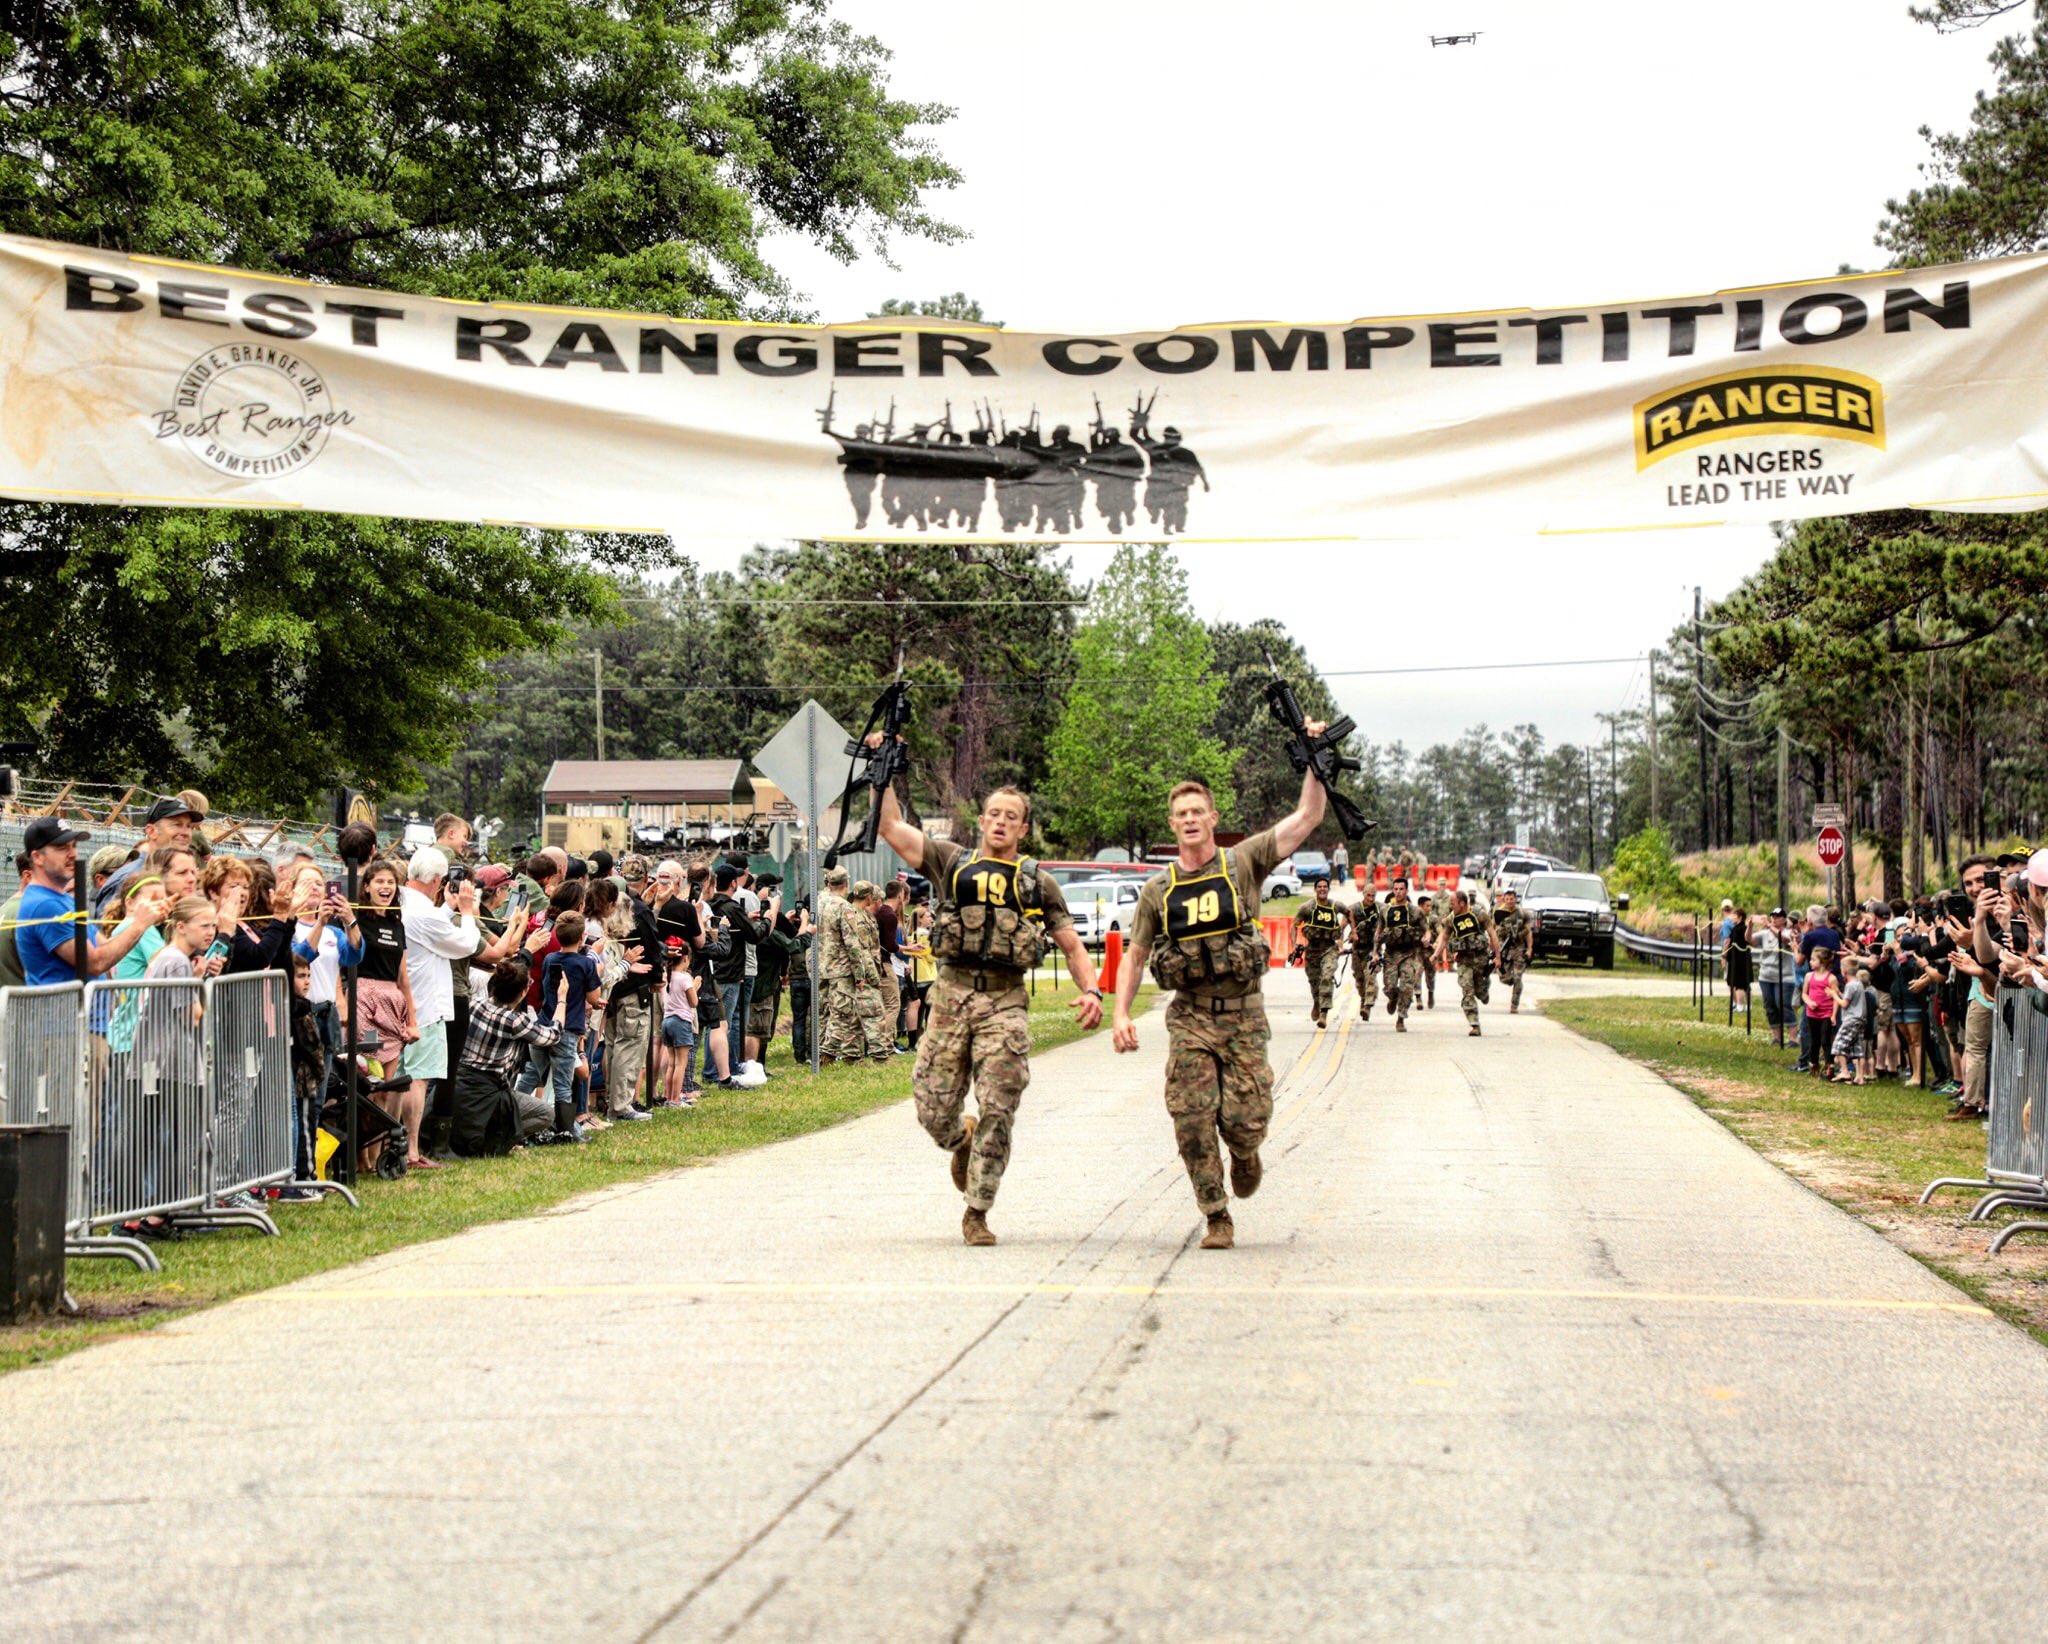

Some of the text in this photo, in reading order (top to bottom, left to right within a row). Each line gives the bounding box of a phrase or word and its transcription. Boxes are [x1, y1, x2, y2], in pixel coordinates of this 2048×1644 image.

[64, 264, 1971, 378] BEST RANGER COMPETITION
[178, 346, 324, 407] DAVID E. GRANGE, JR.
[152, 403, 355, 441] Best Ranger
[1650, 382, 1872, 447] RANGER
[204, 440, 313, 475] COMPETITION
[1697, 449, 1824, 477] RANGERS
[1668, 473, 1855, 507] LEAD THE WAY
[1819, 838, 1843, 855] STOP
[971, 870, 1008, 906] 19
[1181, 889, 1220, 926] 19
